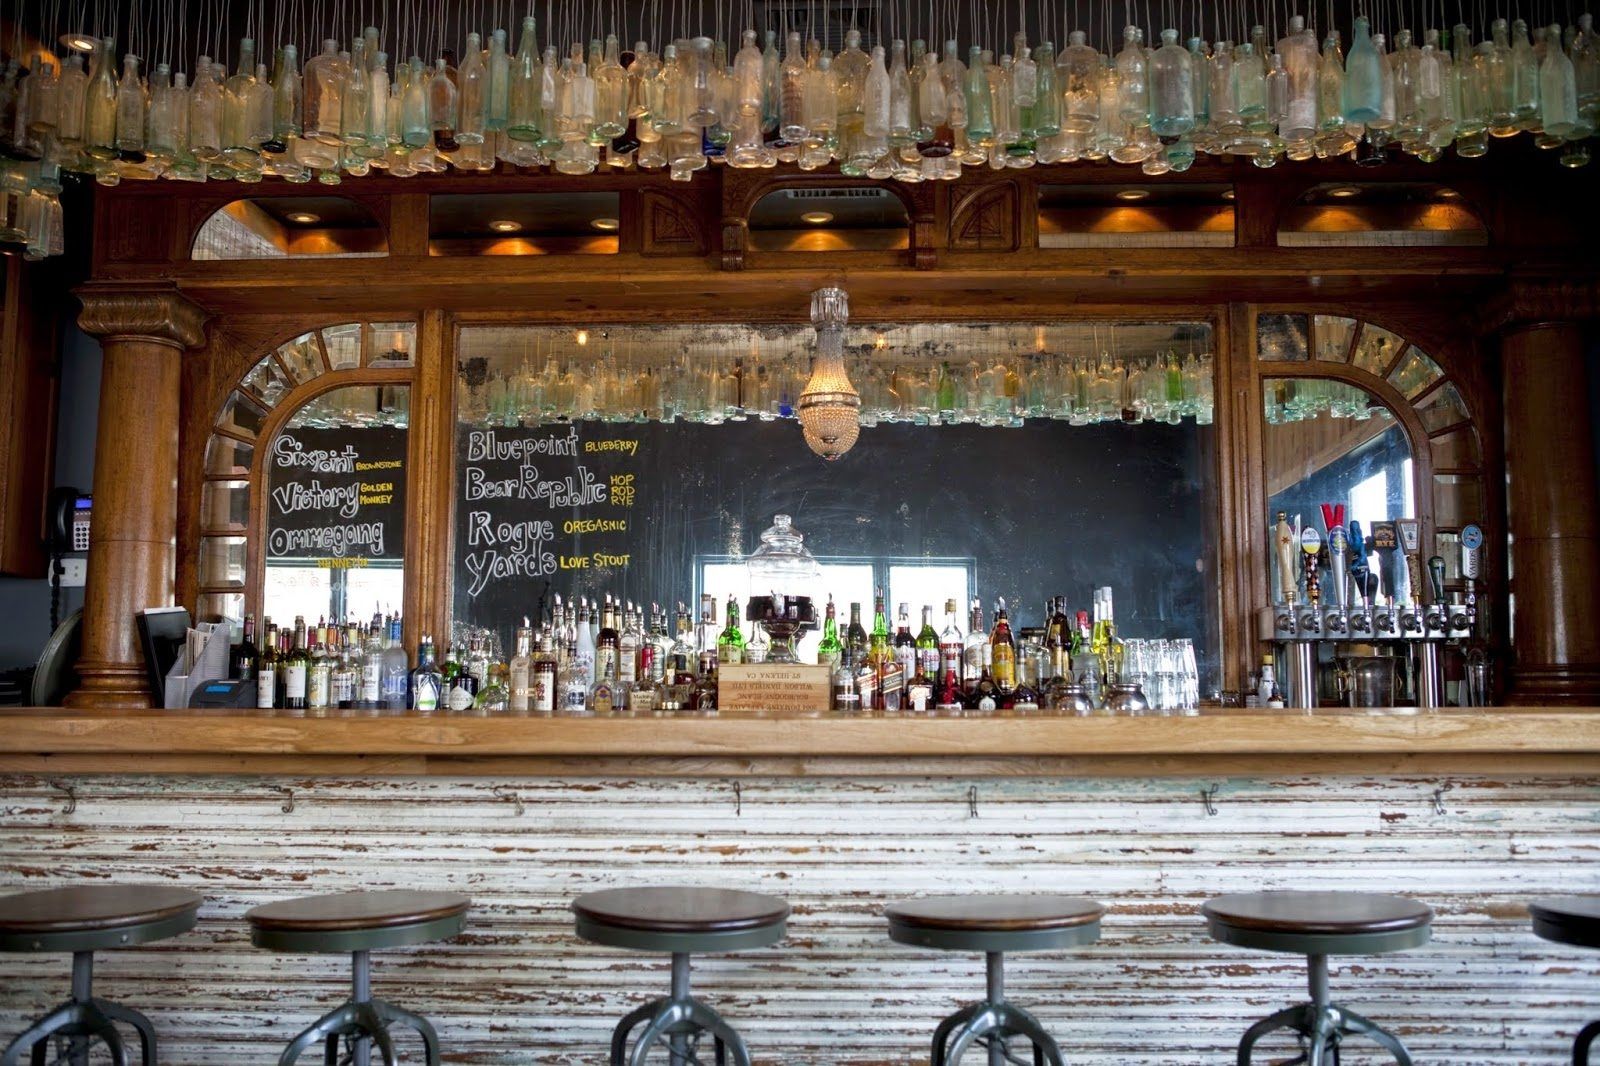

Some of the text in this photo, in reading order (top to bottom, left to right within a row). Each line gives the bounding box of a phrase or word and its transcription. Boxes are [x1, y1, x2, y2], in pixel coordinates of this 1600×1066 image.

[467, 427, 638, 466] Bluepoint BLUEBERRY
[610, 475, 635, 486] HOP
[272, 480, 393, 519] Victory GOLDEN
[359, 495, 393, 505] MONKEY
[610, 486, 636, 496] ROD
[610, 496, 634, 506] RYE
[269, 522, 384, 557] Ommegang
[468, 511, 555, 553] Rogue
[560, 555, 590, 570] LOVE
[593, 552, 630, 568] STOUT
